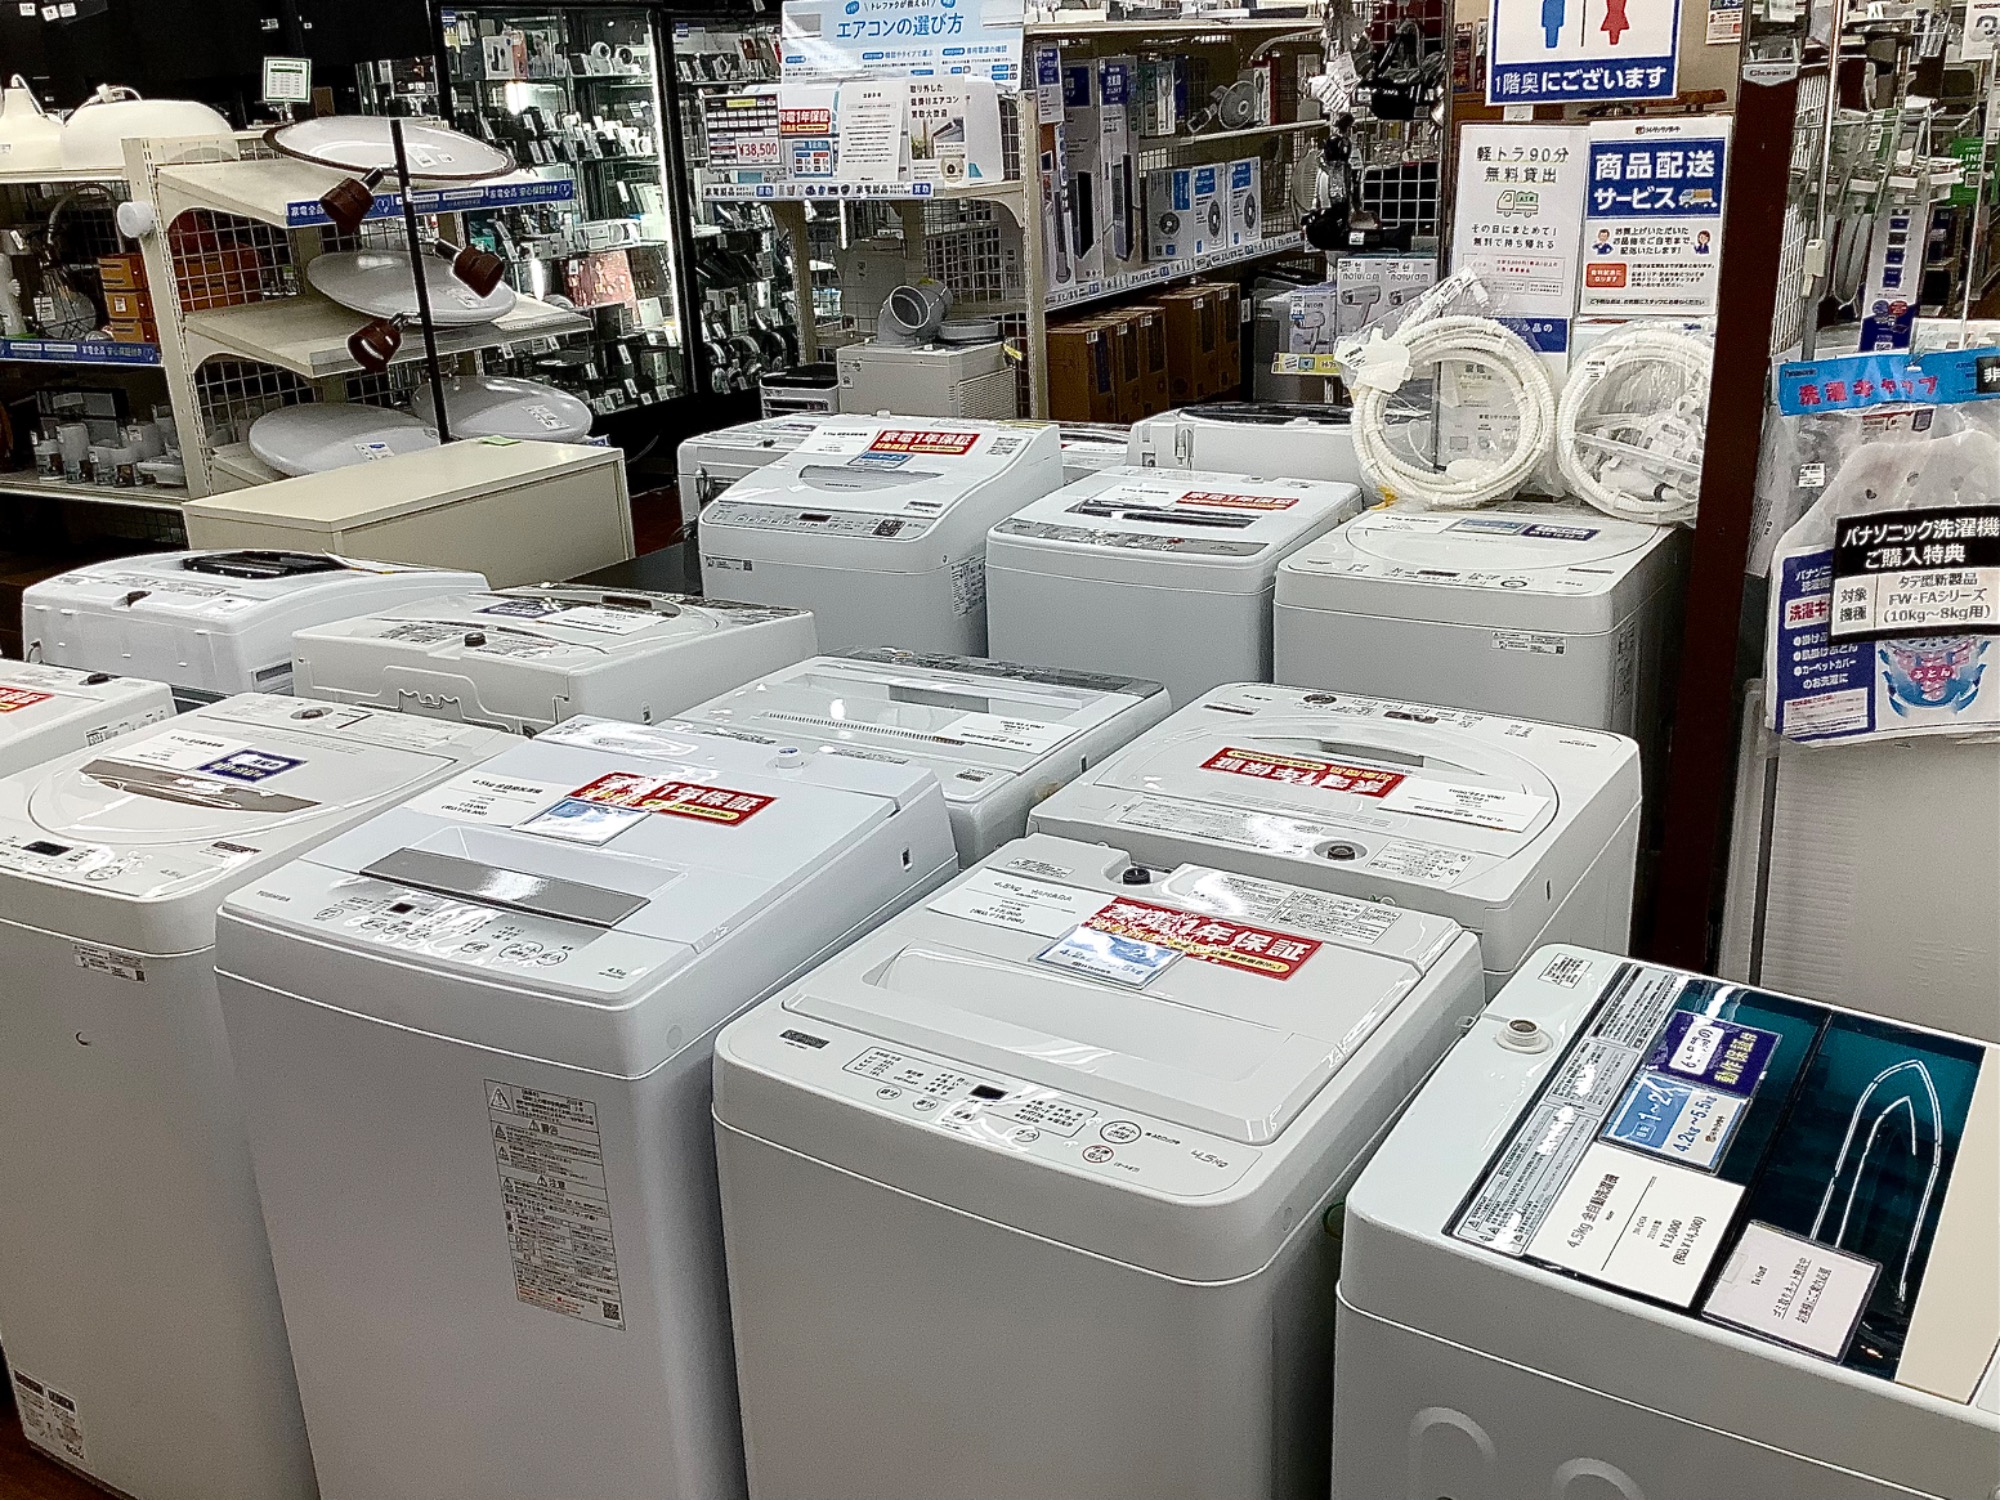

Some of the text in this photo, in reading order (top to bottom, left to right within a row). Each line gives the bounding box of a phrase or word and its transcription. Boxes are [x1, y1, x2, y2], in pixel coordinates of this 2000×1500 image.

[837, 12, 965, 39] エアコンの選び方
[1494, 66, 1667, 95] 1階奥にございます
[1477, 146, 1569, 163] 軽トラ90分
[1595, 149, 1715, 181] 商品配送
[1484, 166, 1558, 184] 無料貸出
[1594, 186, 1675, 210] サービス
[1841, 516, 2000, 548] パナソニック洗濯機
[1865, 543, 1966, 569] ご購入特典
[1898, 572, 1978, 589] タテ型新製品
[1840, 587, 1867, 604] 対象
[1789, 600, 1829, 622] 洗濯キ
[1839, 605, 1867, 622] 機種
[1566, 1220, 1594, 1251] 4.5kg
